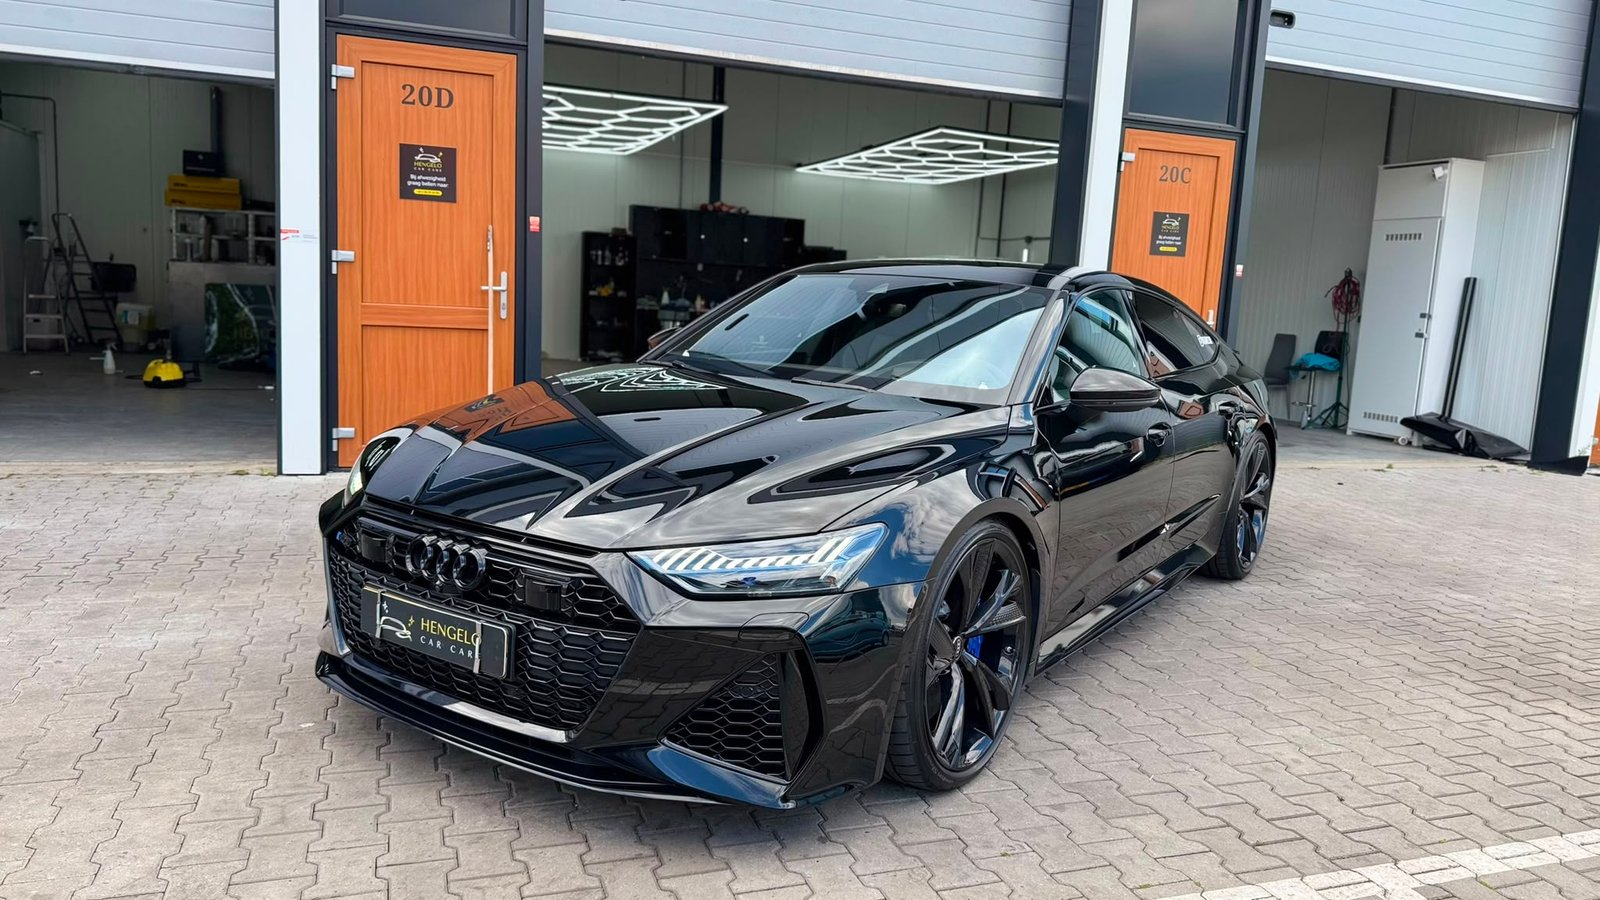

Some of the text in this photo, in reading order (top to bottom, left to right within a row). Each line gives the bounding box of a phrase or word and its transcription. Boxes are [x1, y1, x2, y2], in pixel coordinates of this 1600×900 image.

[401, 84, 454, 108] 20D
[1158, 165, 1192, 184] 20C
[420, 636, 480, 660] CAR CAR
